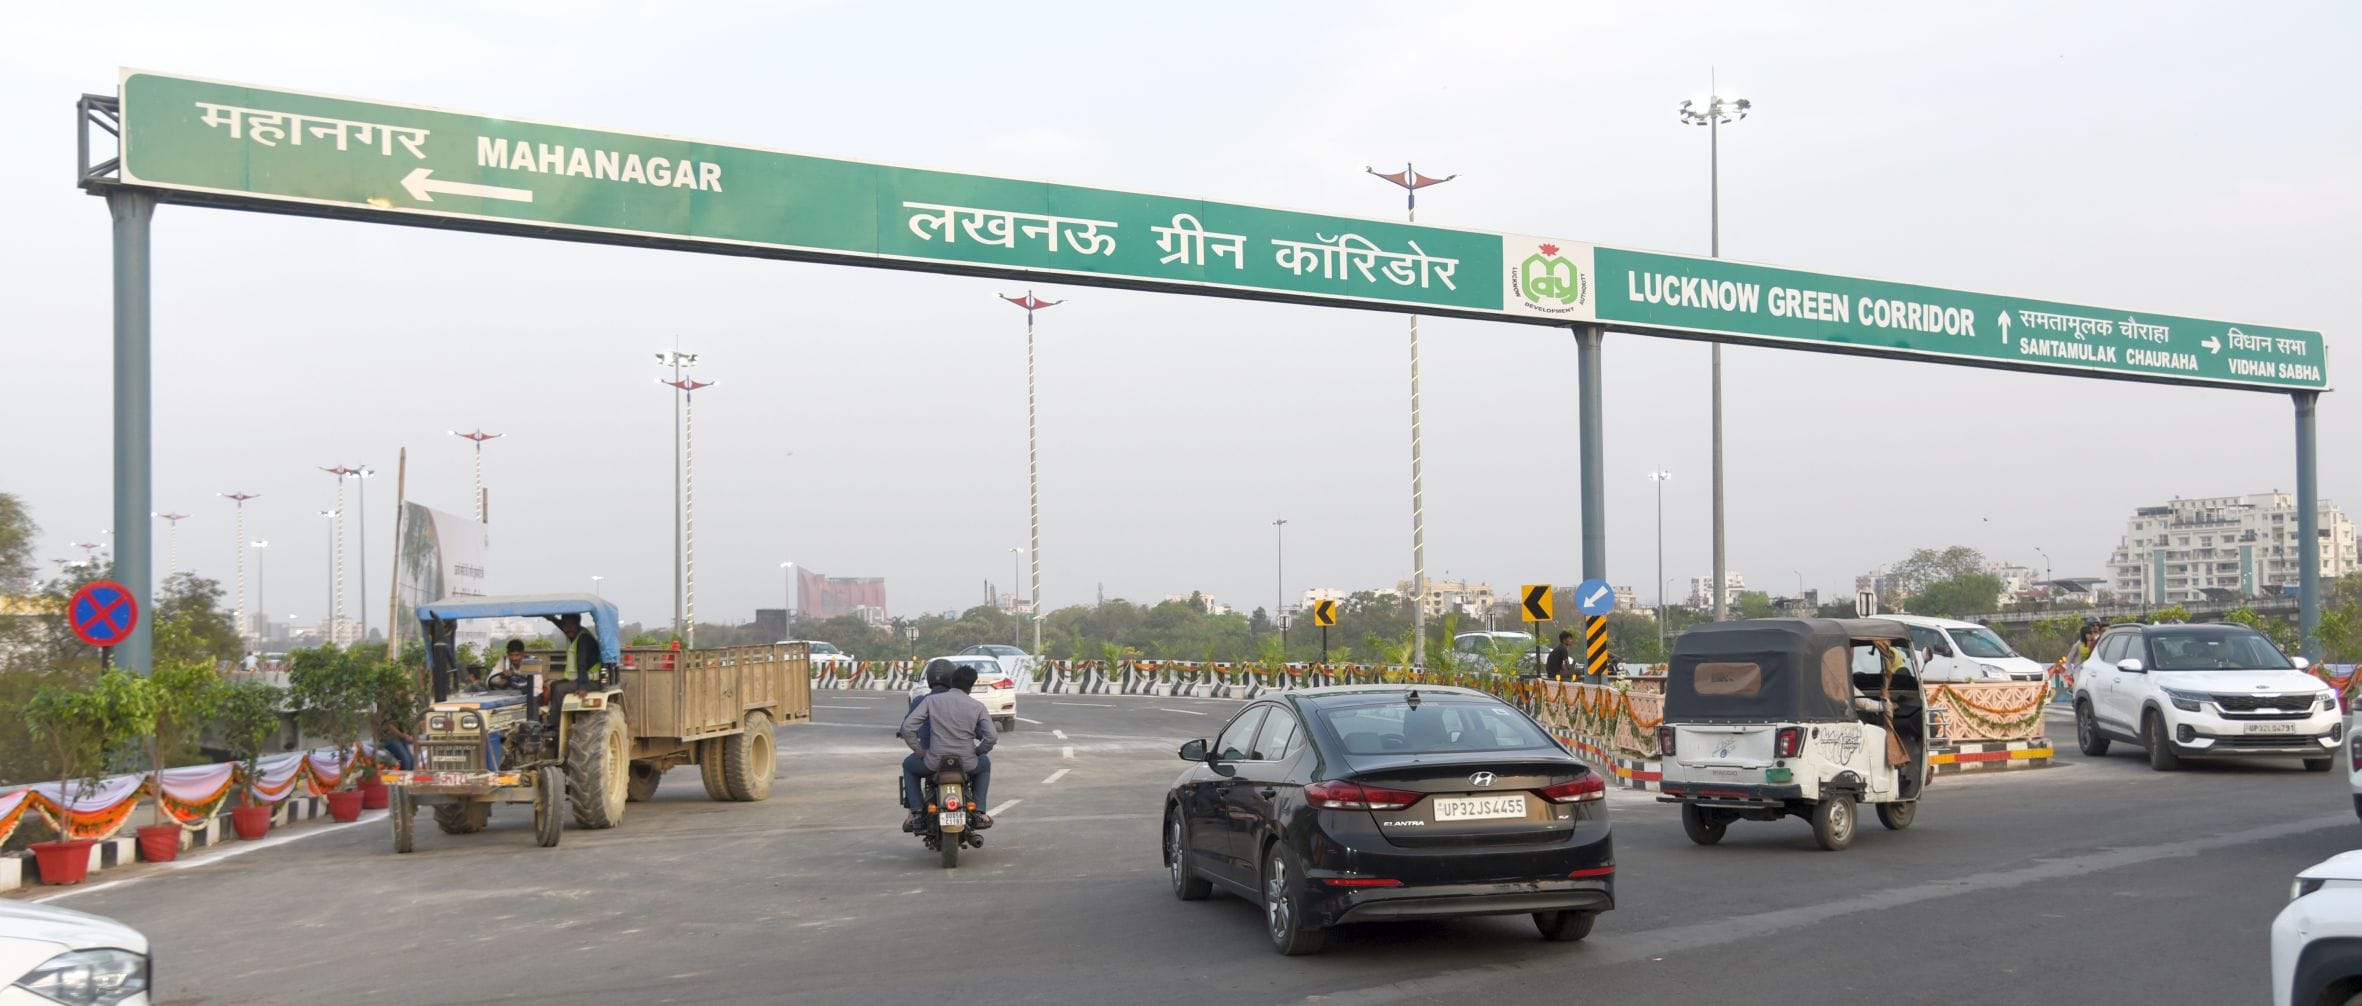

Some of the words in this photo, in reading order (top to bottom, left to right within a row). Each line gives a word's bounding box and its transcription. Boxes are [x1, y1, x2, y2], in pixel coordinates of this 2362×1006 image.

[195, 102, 430, 159] महानगर
[477, 136, 723, 193] MAHANAGAR
[903, 201, 1118, 258] लखनऊ
[1151, 212, 1246, 269] ग्रीन
[1271, 233, 1460, 291] कॉरिडोर
[1524, 302, 1574, 314] DEVELOPMENT
[1628, 269, 1760, 313] LUCKNOW
[1768, 286, 1850, 323] GREEN
[1858, 297, 1975, 338] CORRIDOR
[2018, 310, 2113, 340] समतामूलक
[2118, 317, 2170, 344] चौराहा
[2227, 327, 2272, 353] विधान
[2276, 338, 2307, 356] सभा
[2019, 337, 2117, 363] SAMTAMULAK
[2126, 349, 2199, 371] CHAURAHA
[2228, 358, 2275, 378] VIDHAN
[2278, 363, 2321, 381] SABHA
[1444, 799, 1524, 816] UP32JS4455
